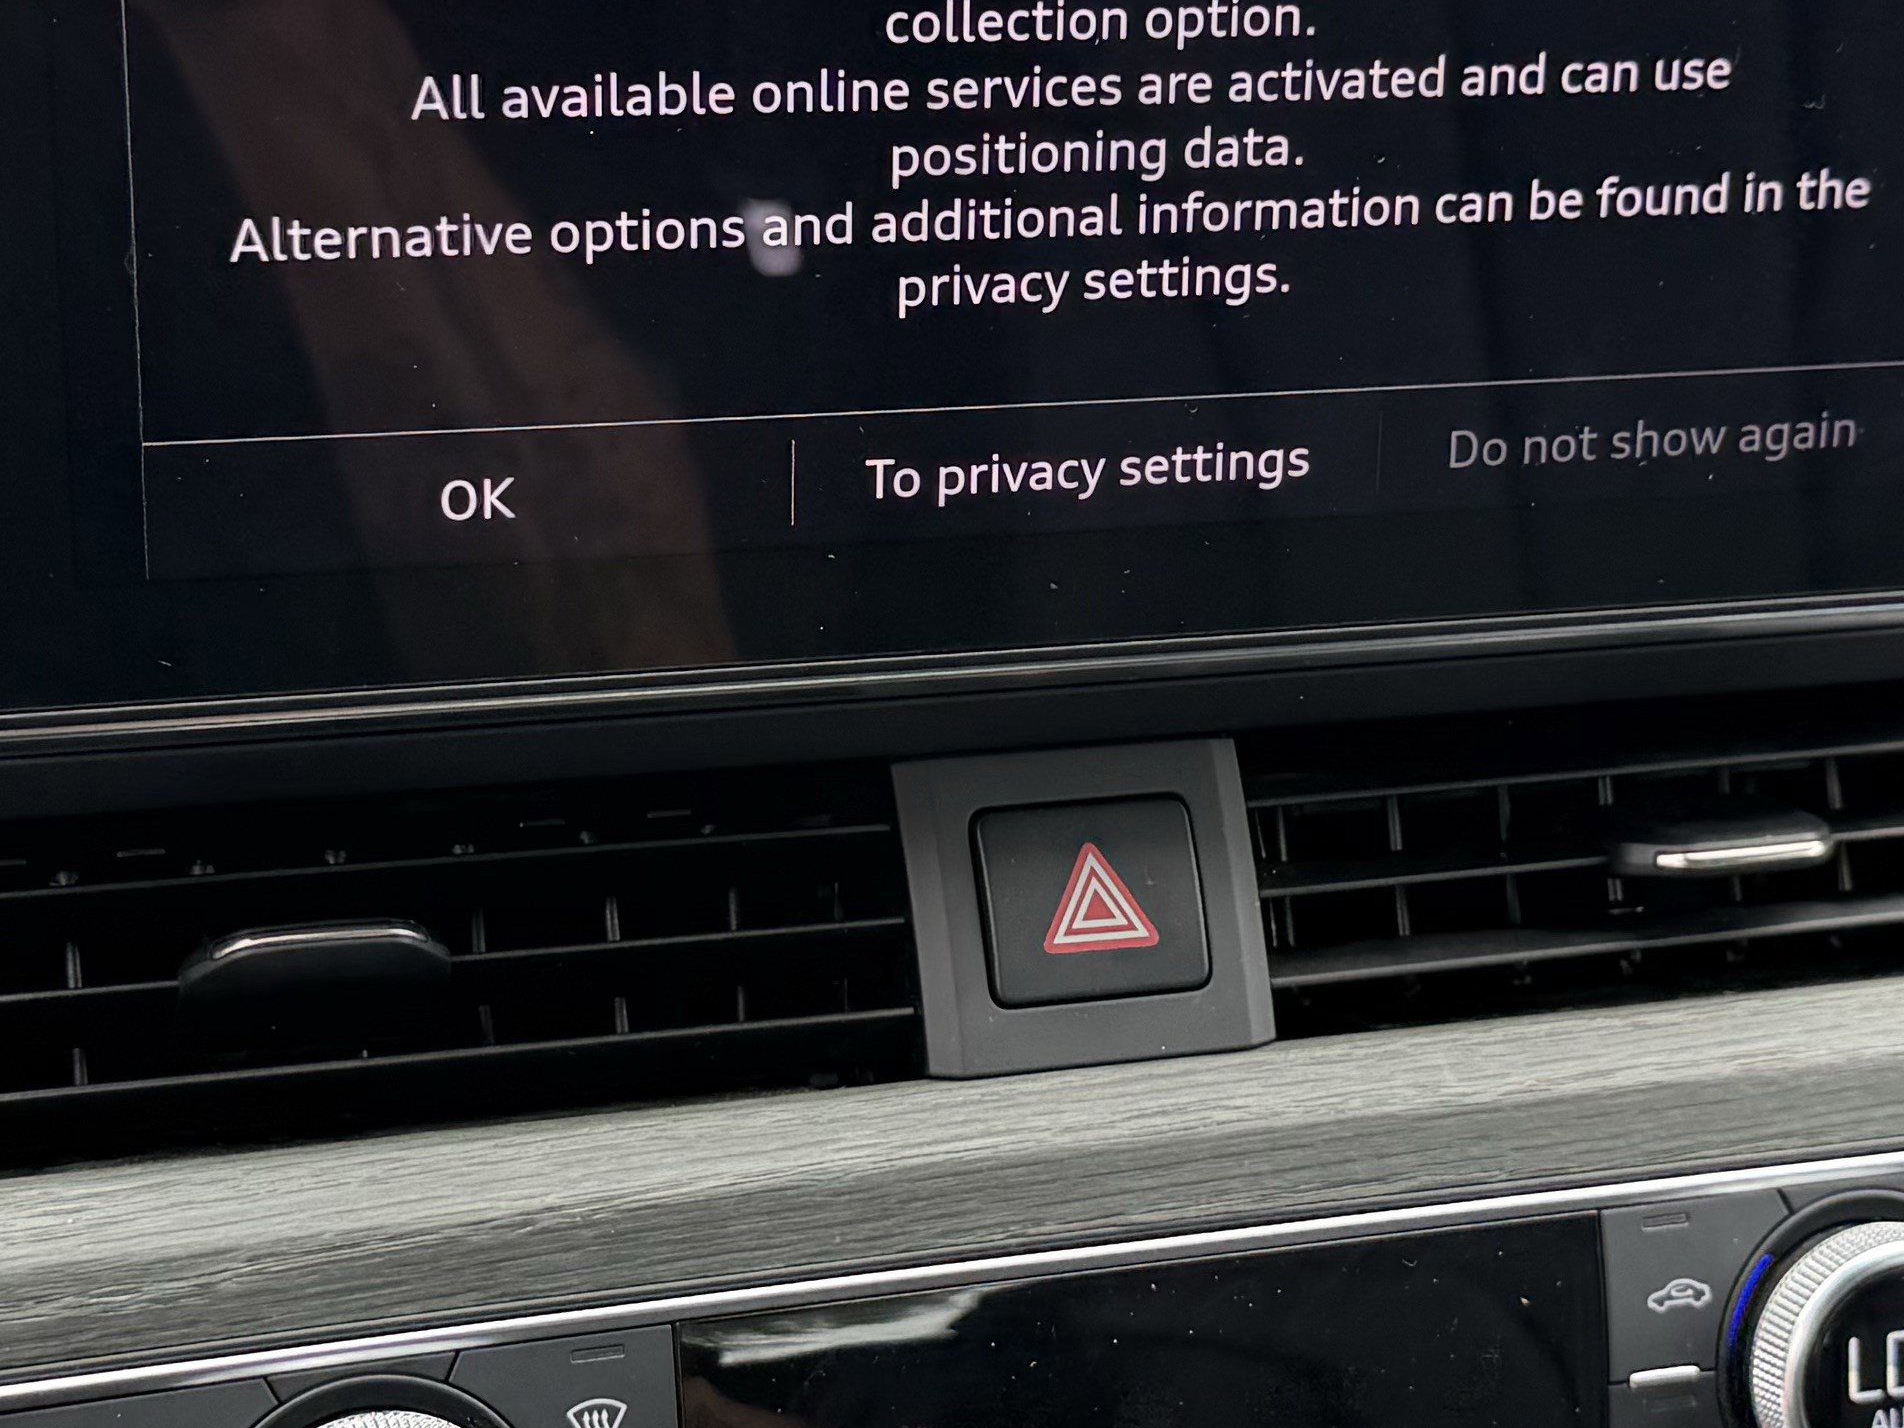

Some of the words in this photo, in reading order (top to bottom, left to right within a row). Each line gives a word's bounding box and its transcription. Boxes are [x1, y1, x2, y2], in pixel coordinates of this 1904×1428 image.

[410, 73, 486, 121] All
[501, 70, 736, 119] available
[752, 67, 910, 114] online
[926, 64, 1122, 110] services
[1137, 72, 1213, 105] are
[1228, 53, 1446, 103] activated
[1460, 50, 1547, 97] and
[1561, 60, 1639, 94] can
[1654, 57, 1732, 91] use
[891, 129, 1167, 190] positioning
[1184, 124, 1304, 169] data.
[229, 212, 533, 263] Alternative
[550, 208, 745, 265] options
[762, 201, 853, 247] and
[871, 192, 1123, 243] additional
[1138, 186, 1420, 235] information
[1435, 191, 1514, 224] can
[1529, 178, 1584, 221] be
[1595, 171, 1731, 219] found
[1743, 171, 1783, 213] in
[1796, 167, 1871, 211] the
[898, 263, 1070, 319] privacy
[1083, 255, 1290, 307] settings.
[1449, 428, 1508, 469] Do
[1523, 425, 1598, 466] not
[1610, 419, 1727, 461] show
[1738, 410, 1857, 462] again
[440, 476, 517, 522] OK
[864, 458, 921, 500] To
[937, 453, 1107, 508] privacy
[1119, 441, 1310, 491] settings
